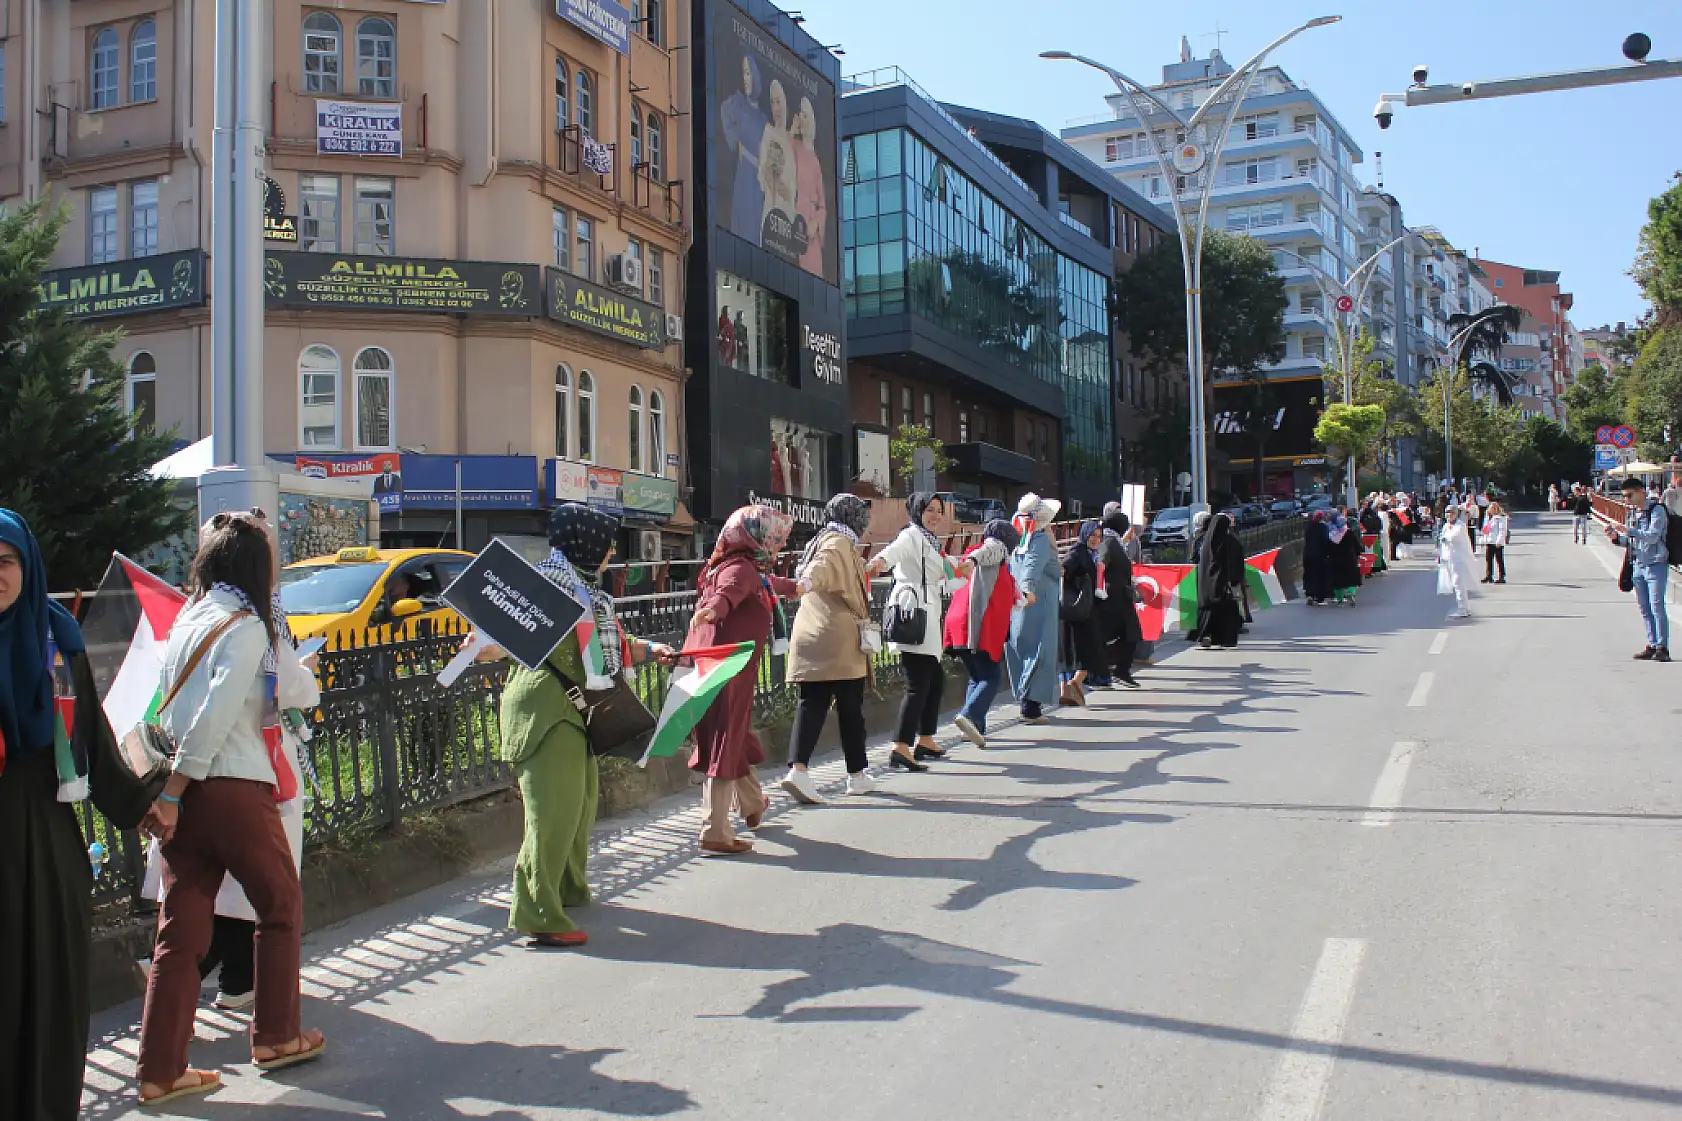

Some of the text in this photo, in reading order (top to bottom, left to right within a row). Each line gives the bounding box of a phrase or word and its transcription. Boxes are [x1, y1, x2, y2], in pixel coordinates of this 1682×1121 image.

[329, 259, 460, 279] ALMİLA
[94, 288, 165, 312] MERKEZİ
[297, 282, 359, 294] GÜZELLİK
[570, 308, 648, 343] GÜZELLİK MERKEZİ
[574, 287, 643, 329] ALMİLA
[803, 324, 841, 361] Tesettür
[787, 495, 827, 531] Boutiqu
[480, 584, 537, 633] Mümkün
[483, 569, 505, 587] Daha
[528, 603, 555, 629] Dünya
